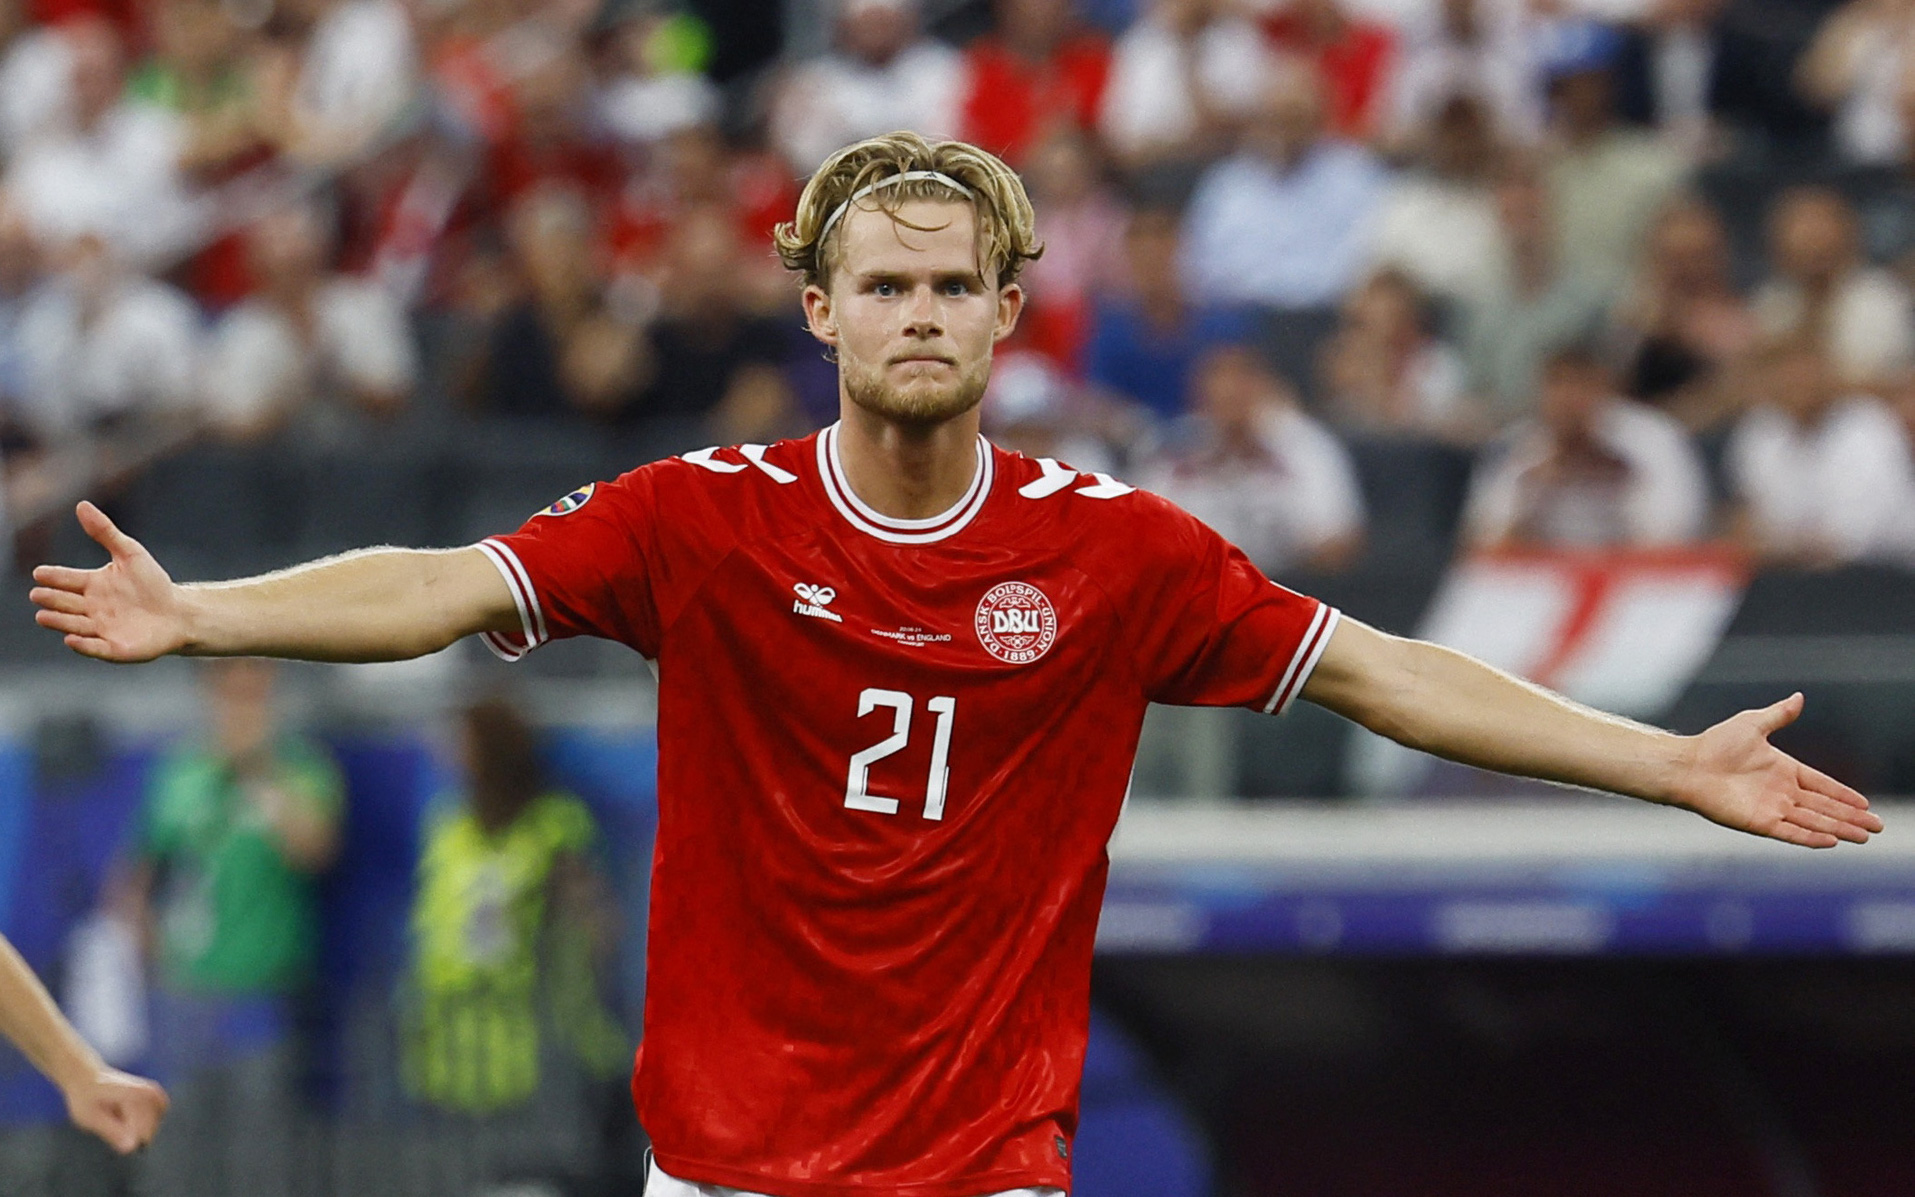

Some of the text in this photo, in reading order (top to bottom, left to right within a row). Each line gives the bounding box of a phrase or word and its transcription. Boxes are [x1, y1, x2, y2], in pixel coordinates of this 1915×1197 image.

[793, 599, 843, 623] humm
[992, 608, 1040, 634] DBU
[916, 633, 952, 642] ENGLAND
[978, 606, 1000, 653] DANSK
[1036, 607, 1053, 651] UNION
[1003, 650, 1036, 661] 1889
[843, 687, 956, 821] 21
